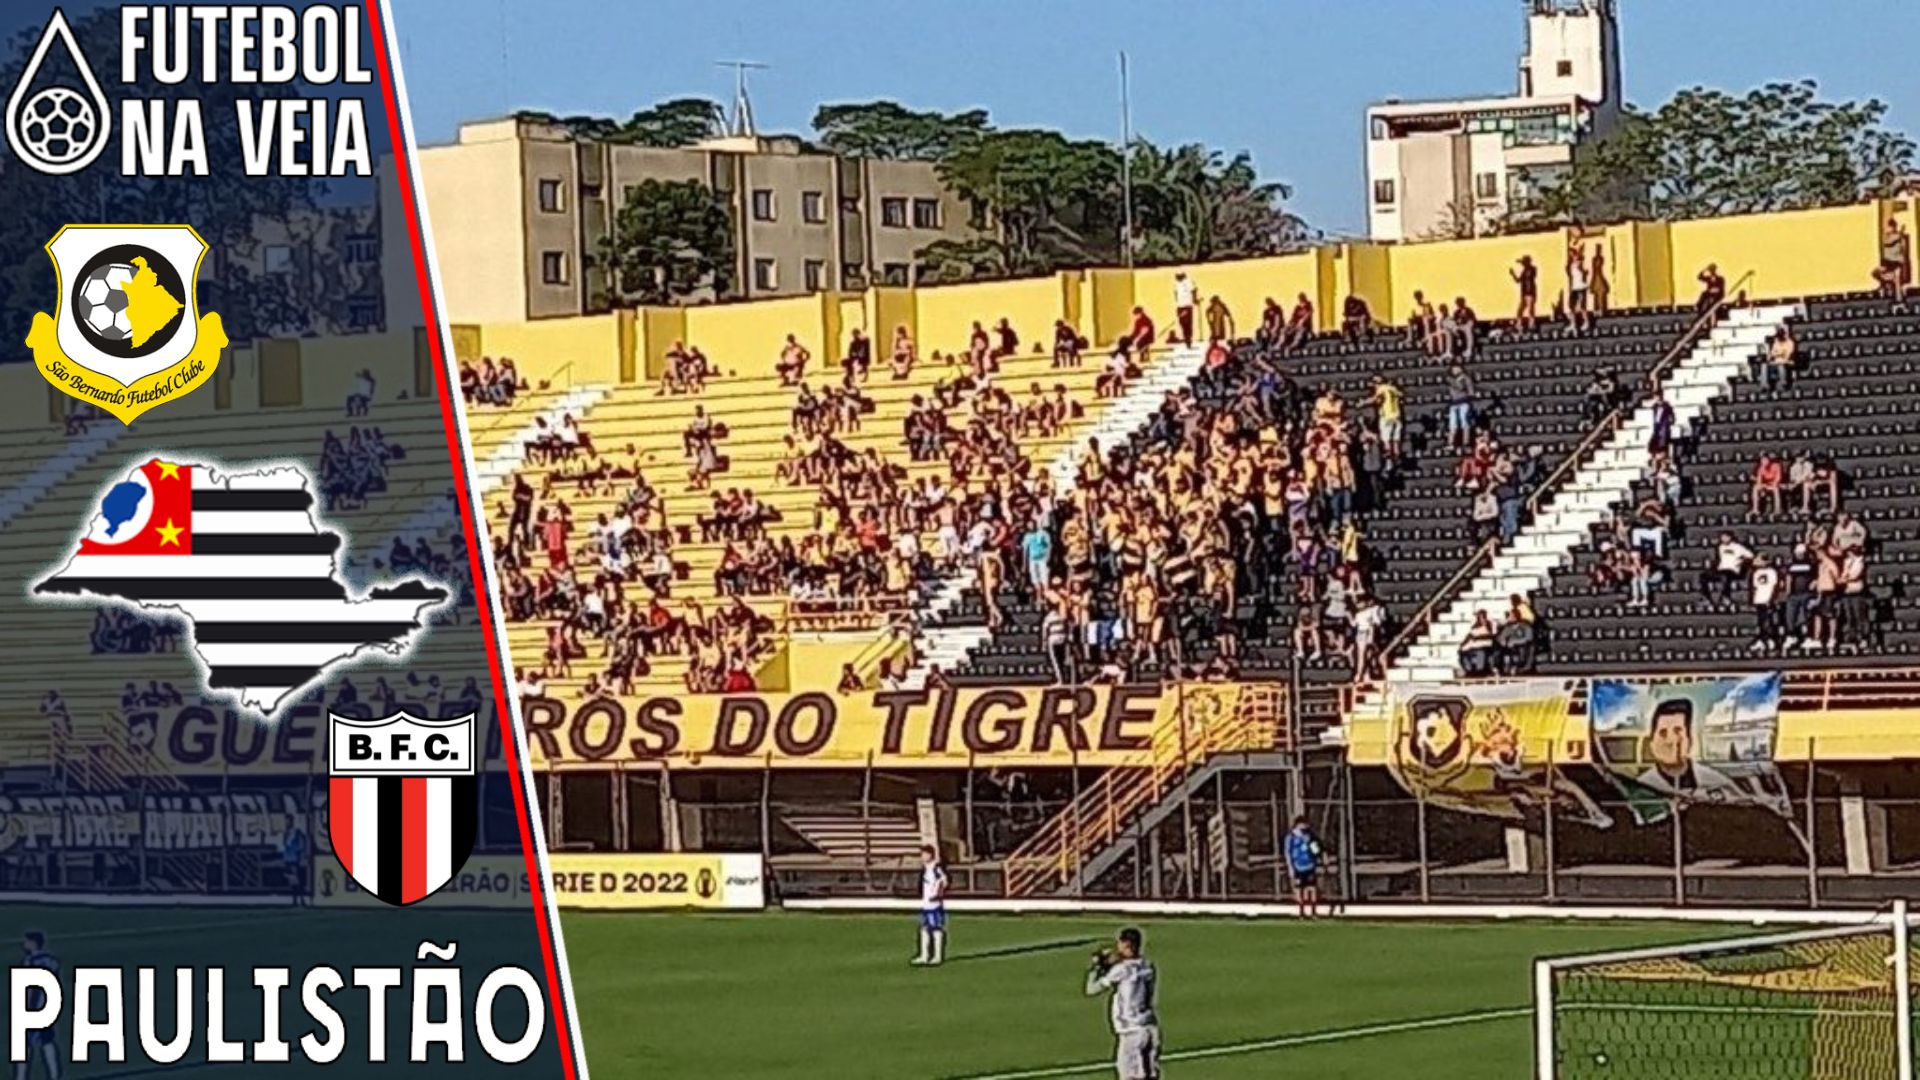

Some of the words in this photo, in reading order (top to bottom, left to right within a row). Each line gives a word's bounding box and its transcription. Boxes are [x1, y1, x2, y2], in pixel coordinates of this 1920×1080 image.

[711, 691, 838, 757] DO
[872, 685, 1163, 754] TIGRE
[519, 872, 596, 893] SRIE
[600, 872, 618, 893] D
[622, 872, 689, 893] 2022
